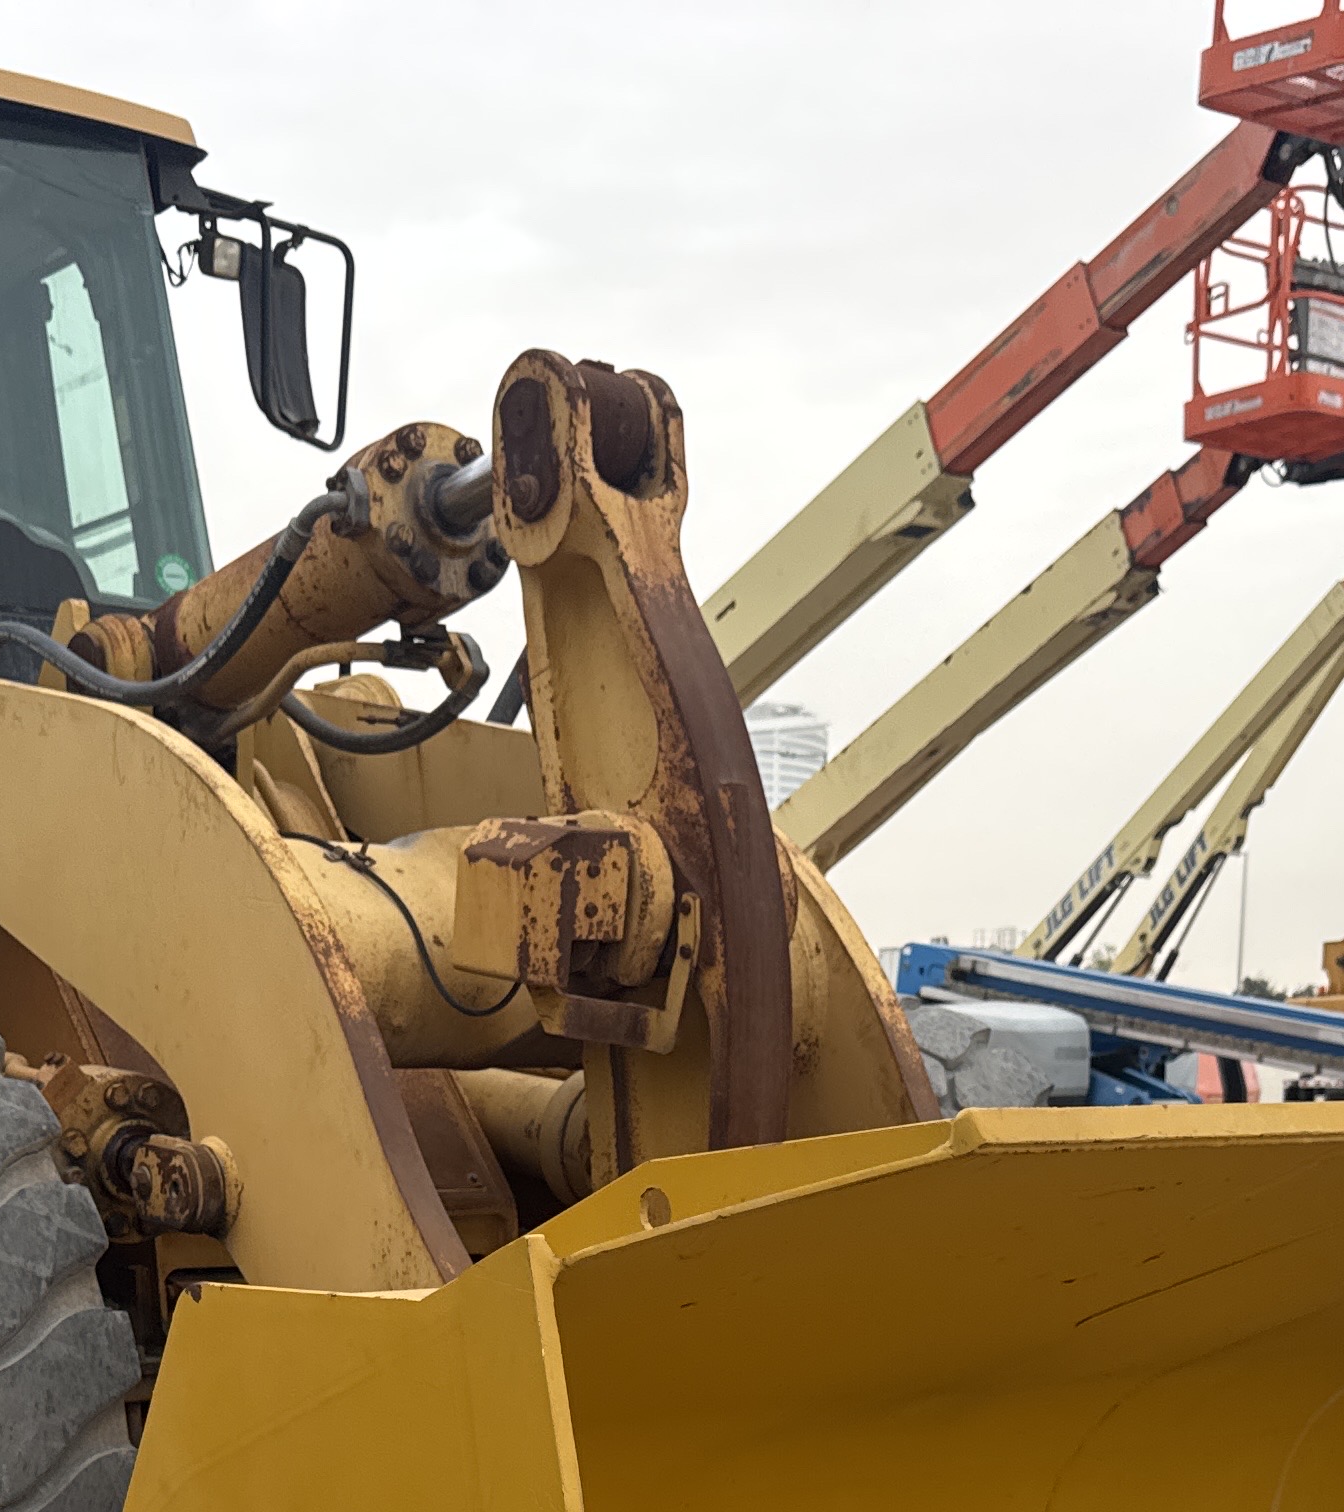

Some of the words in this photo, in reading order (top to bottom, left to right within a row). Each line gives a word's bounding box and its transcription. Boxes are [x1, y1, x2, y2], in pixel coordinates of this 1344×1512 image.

[1043, 893, 1075, 940] JLG
[1078, 842, 1116, 899] LIFT
[1147, 884, 1176, 931] JLG
[1174, 831, 1208, 887] LIFT
